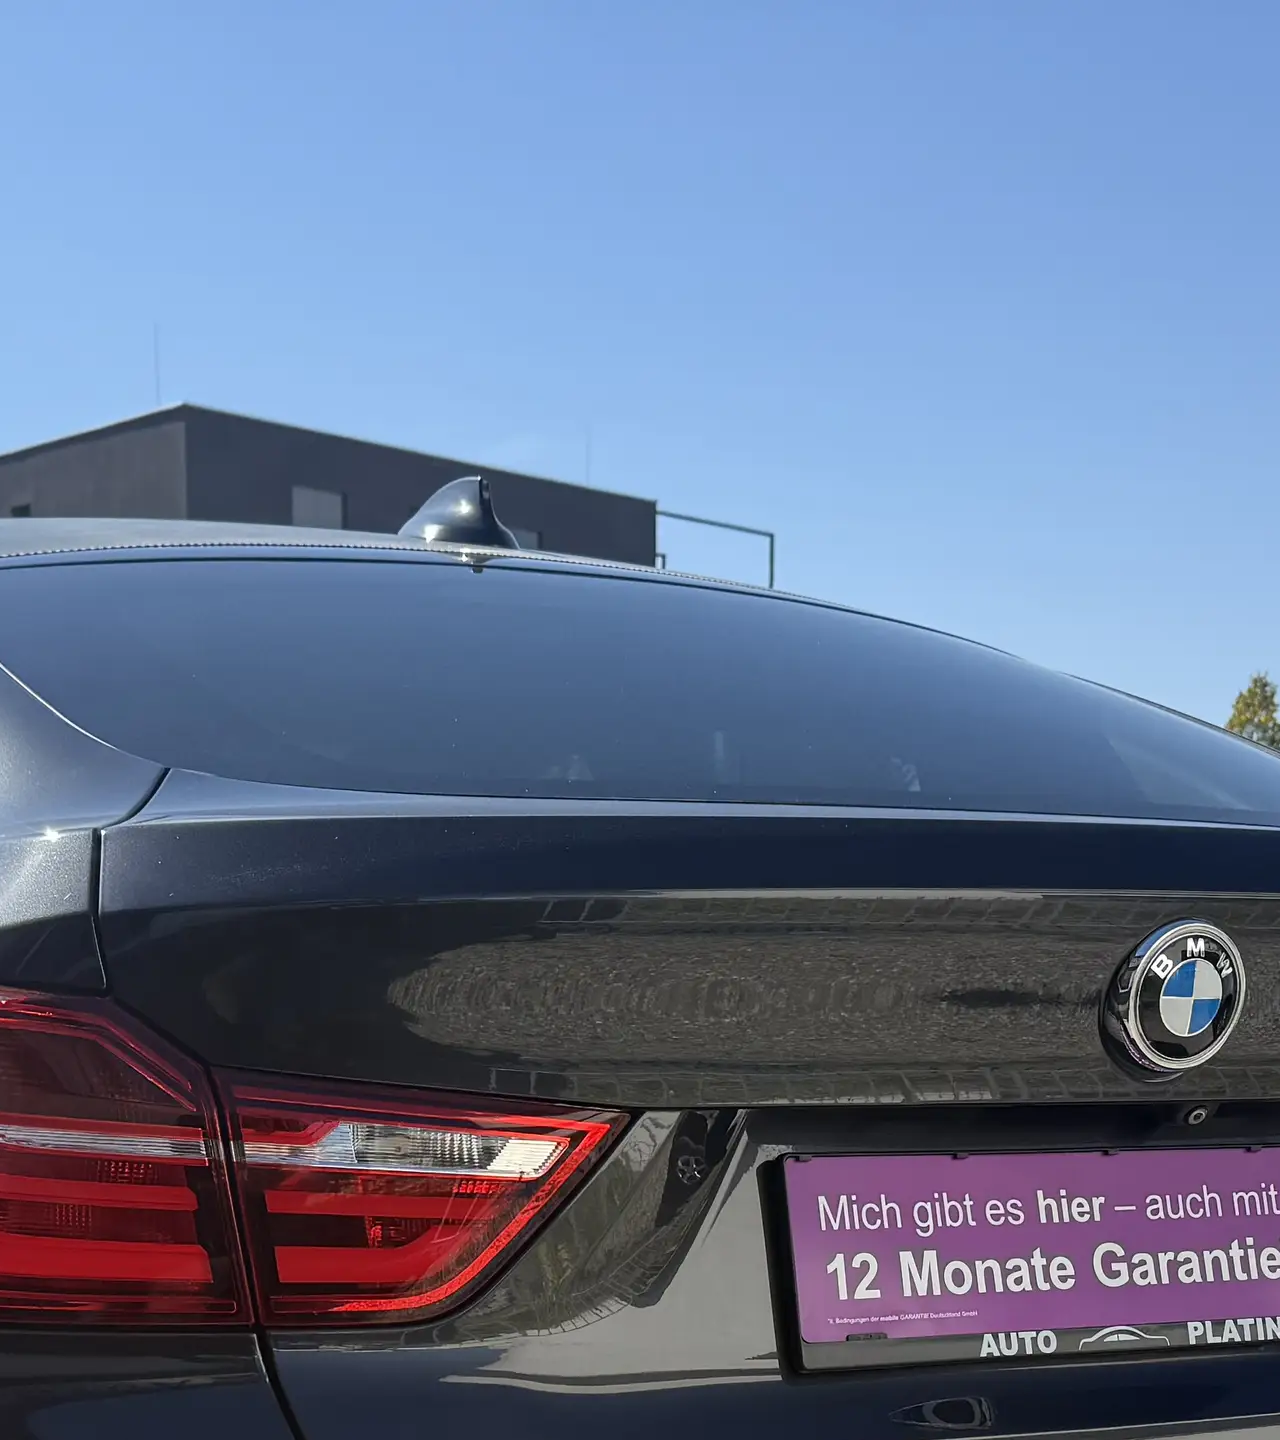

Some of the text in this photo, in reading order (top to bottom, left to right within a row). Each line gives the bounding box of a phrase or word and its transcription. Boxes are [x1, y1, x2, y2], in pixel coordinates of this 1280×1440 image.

[1151, 937, 1233, 979] BMW
[817, 1194, 903, 1231] Mich
[913, 1192, 977, 1237] gibt
[985, 1198, 1025, 1226] es
[1037, 1189, 1105, 1224] hier
[1145, 1184, 1223, 1220] auch
[1232, 1183, 1280, 1217] mit
[826, 1252, 882, 1301] 12
[899, 1247, 1076, 1297] Monate
[870, 1315, 880, 1323] der
[980, 1330, 1057, 1358] AUTO
